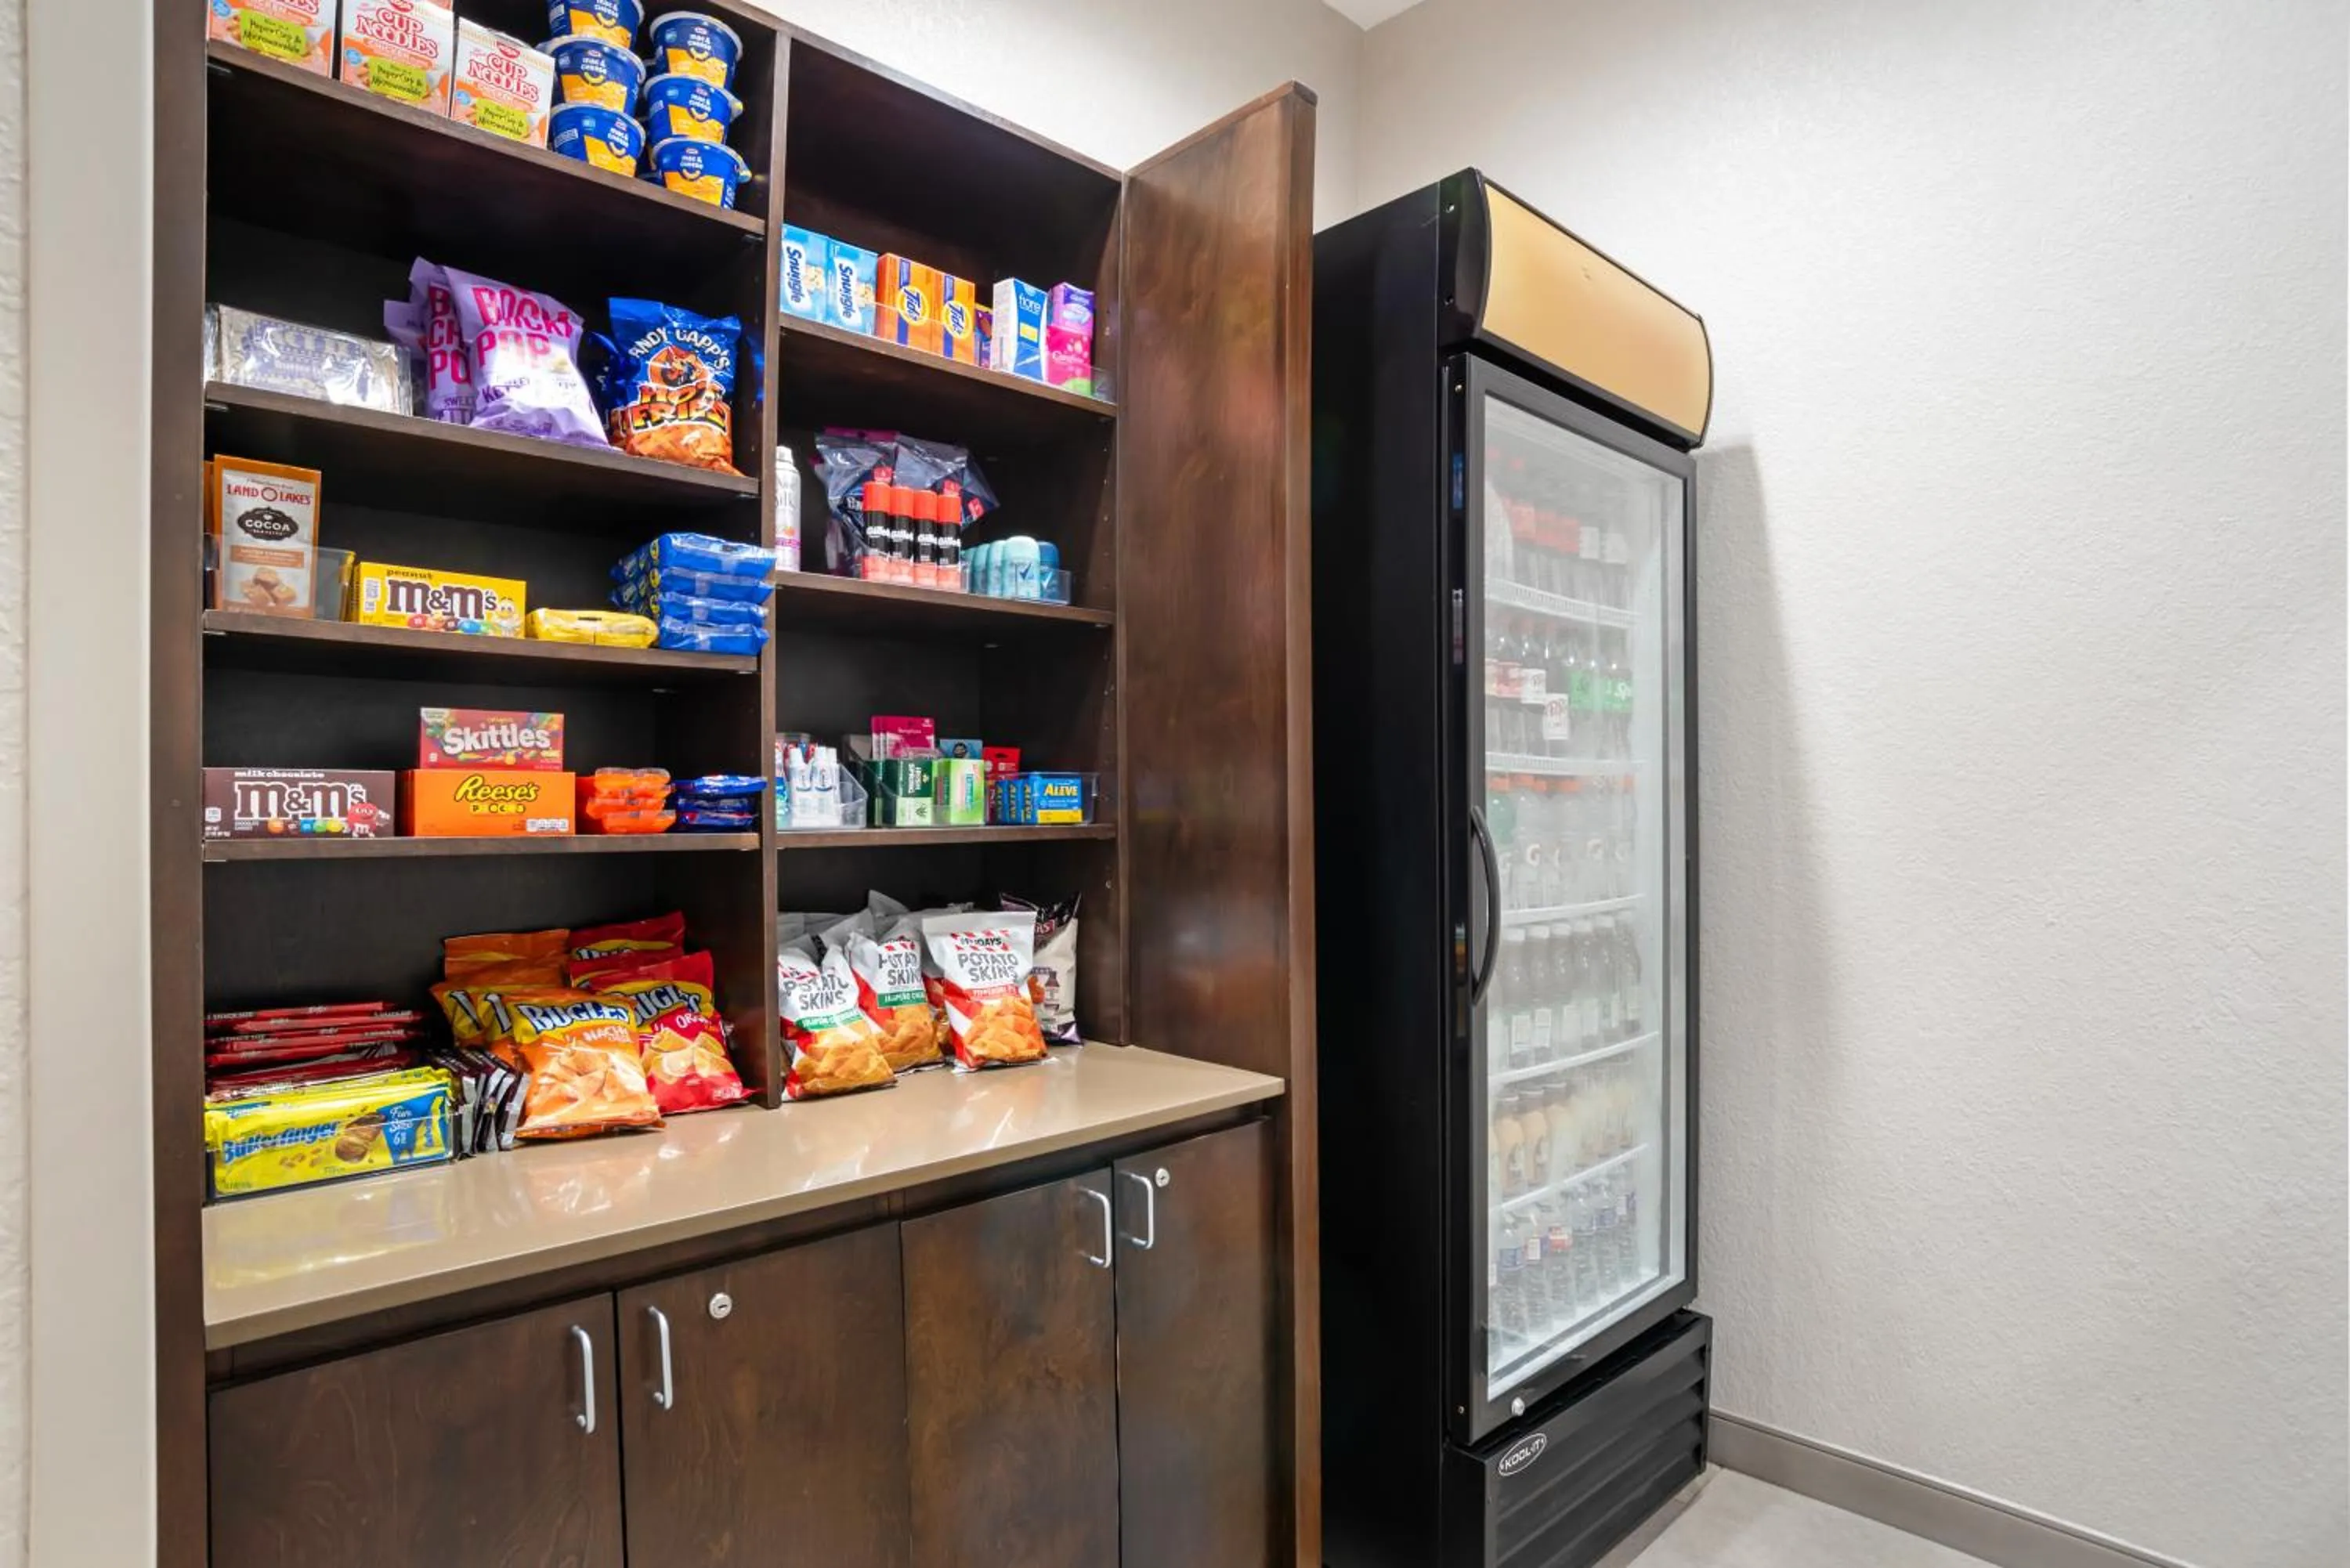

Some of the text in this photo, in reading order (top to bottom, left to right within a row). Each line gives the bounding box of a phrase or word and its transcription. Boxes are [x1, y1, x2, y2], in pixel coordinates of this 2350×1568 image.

[375, 7, 425, 34] CUP
[355, 13, 439, 59] NOODLES
[487, 52, 527, 79] CUP
[467, 60, 539, 103] NOODLES
[786, 246, 804, 303] Snuggle
[839, 262, 856, 320] Snuggle
[904, 287, 921, 321] Tide
[948, 300, 964, 334] Tide
[628, 326, 730, 370] ANDY CAPP'S
[226, 483, 311, 505] LAND O LAKES
[244, 519, 291, 532] COCOA
[386, 569, 432, 580] peanut
[387, 578, 497, 620] m&m's
[443, 723, 551, 755] Skittles
[235, 770, 325, 779] milk chocolate
[454, 774, 540, 802] Reese's
[235, 781, 368, 821] m&m's
[1043, 783, 1079, 797] ALEVE
[960, 936, 1002, 947] DAYS
[957, 952, 1018, 969] POTATO
[968, 964, 1018, 983] SKINS
[887, 968, 923, 986] SKIN
[629, 983, 701, 1028] UGLES
[798, 990, 847, 1010] SKINS
[517, 1001, 630, 1034] BUGLES
[582, 1025, 629, 1042] NACH
[223, 1120, 341, 1165] Butterfinger
